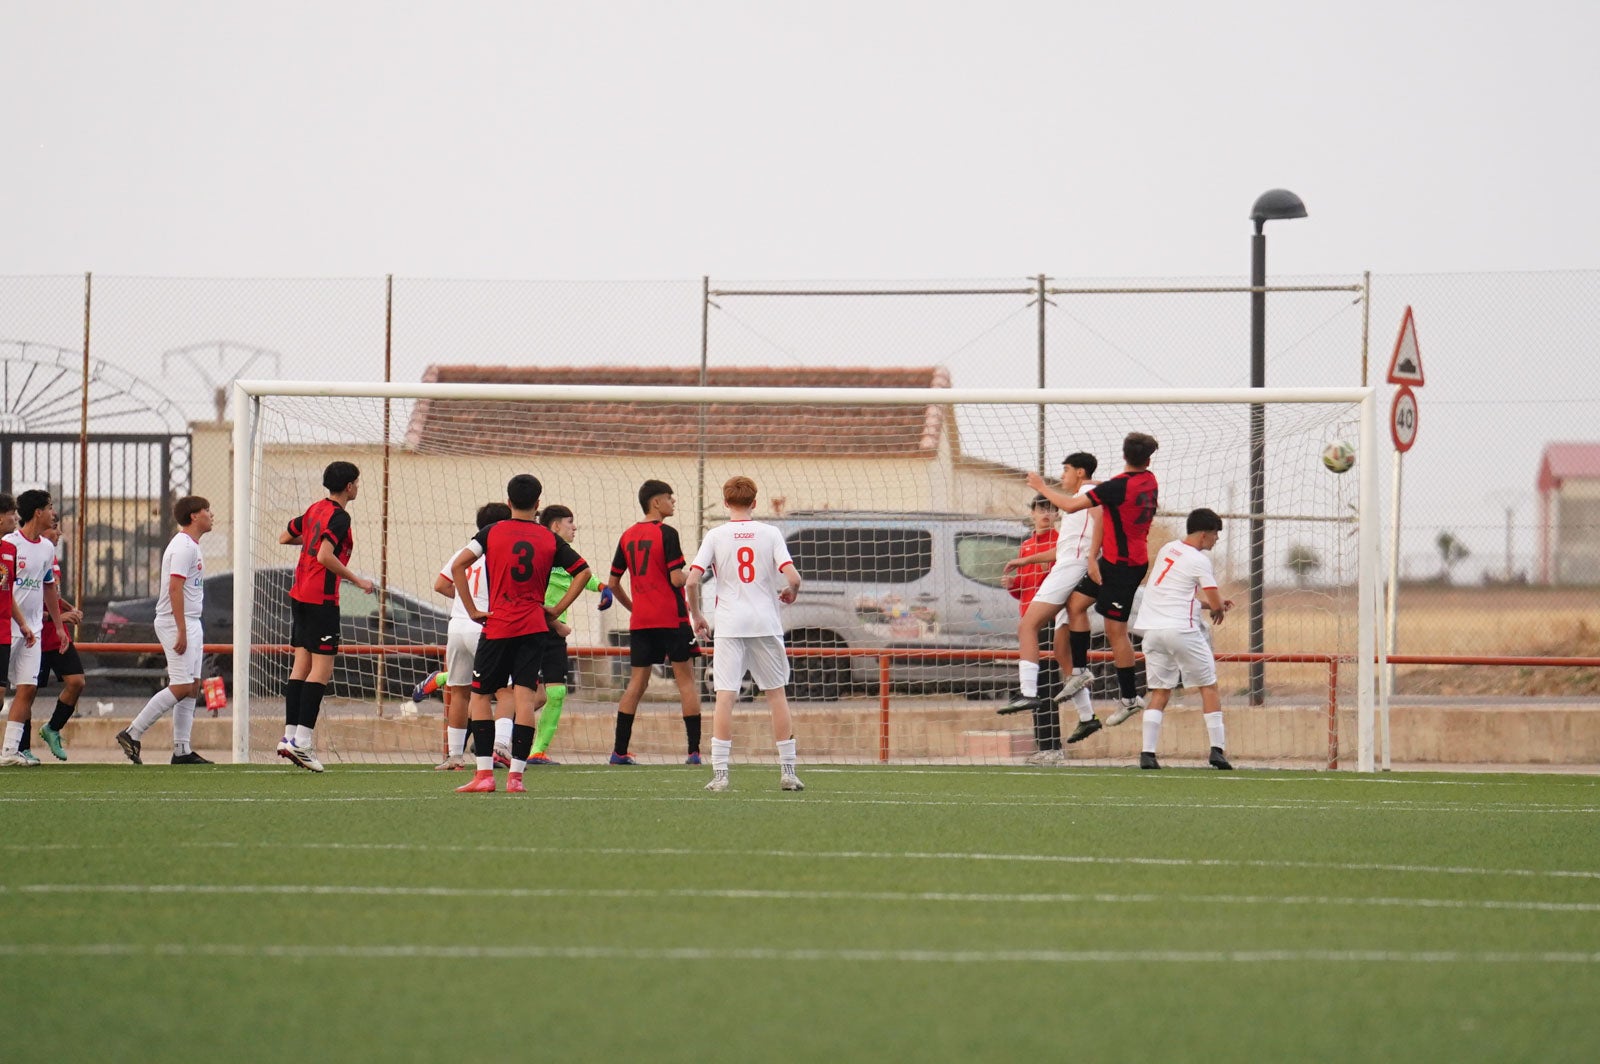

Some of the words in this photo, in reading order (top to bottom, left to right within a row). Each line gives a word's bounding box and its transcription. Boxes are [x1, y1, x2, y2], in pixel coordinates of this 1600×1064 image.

[1396, 408, 1413, 429] 40
[510, 541, 534, 583] 3
[626, 540, 654, 577] 17
[737, 546, 755, 584] 8
[1154, 557, 1175, 587] 7
